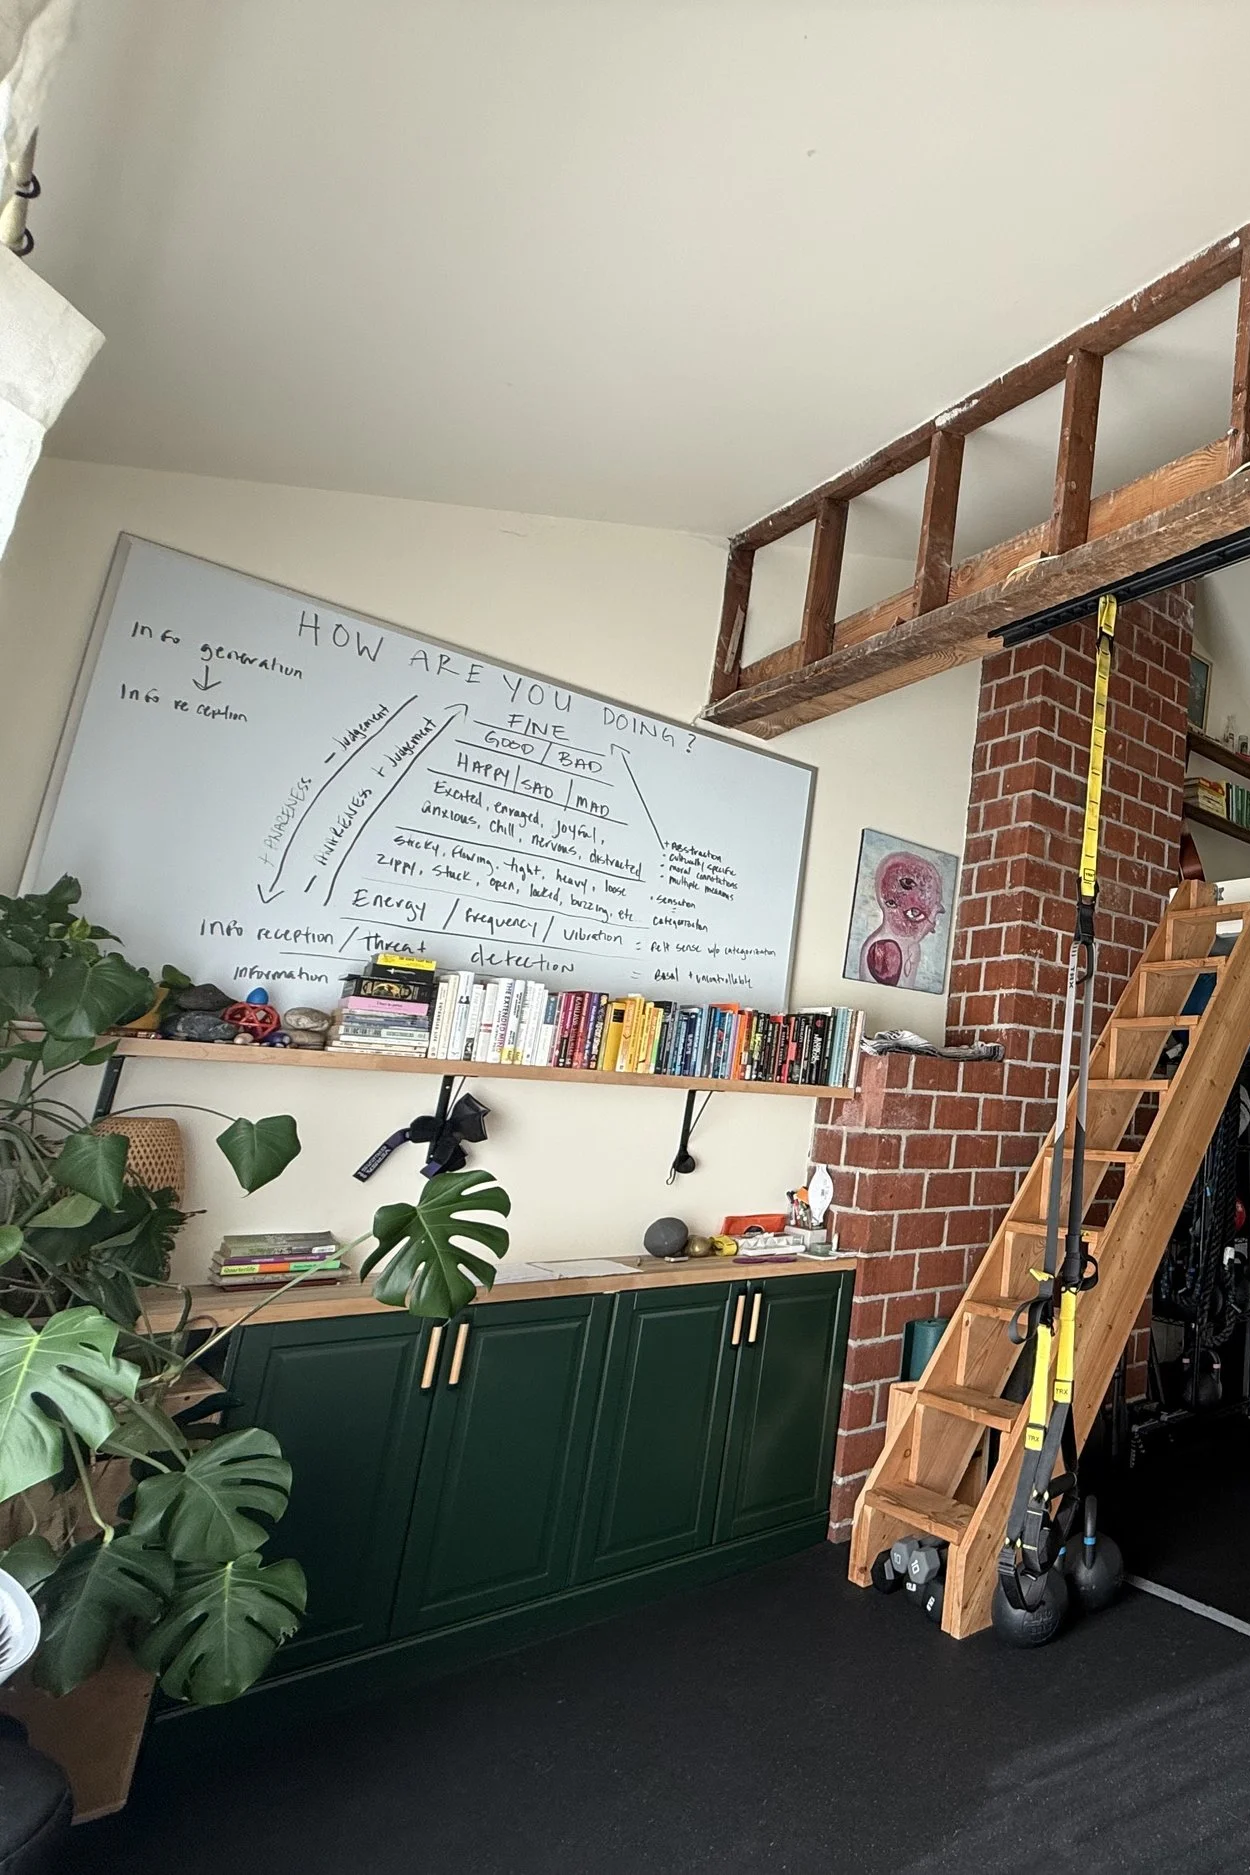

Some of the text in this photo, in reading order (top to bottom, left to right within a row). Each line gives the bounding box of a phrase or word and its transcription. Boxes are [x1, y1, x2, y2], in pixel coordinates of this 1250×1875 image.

[131, 621, 302, 679] Info generation
[298, 610, 384, 662] HOW
[409, 649, 485, 684] ARE
[502, 674, 573, 713] YOU
[121, 683, 159, 703] Info
[508, 713, 571, 742] FINE
[484, 730, 603, 774] GOOD BAD
[456, 752, 610, 817] HAPPY SAD MAD
[589, 848, 642, 882] distracted
[604, 879, 628, 897] loose
[352, 888, 427, 923] Energy
[199, 918, 244, 937] Info
[256, 926, 334, 945] reception
[364, 930, 427, 955] Threat
[470, 943, 575, 973] detection
[233, 964, 329, 984] Information
[505, 982, 513, 994] THE
[499, 996, 511, 1032] EXTENDED
[496, 1033, 505, 1053] MIND
[1028, 1434, 1040, 1442] TRX
[911, 1559, 920, 1575] 10
